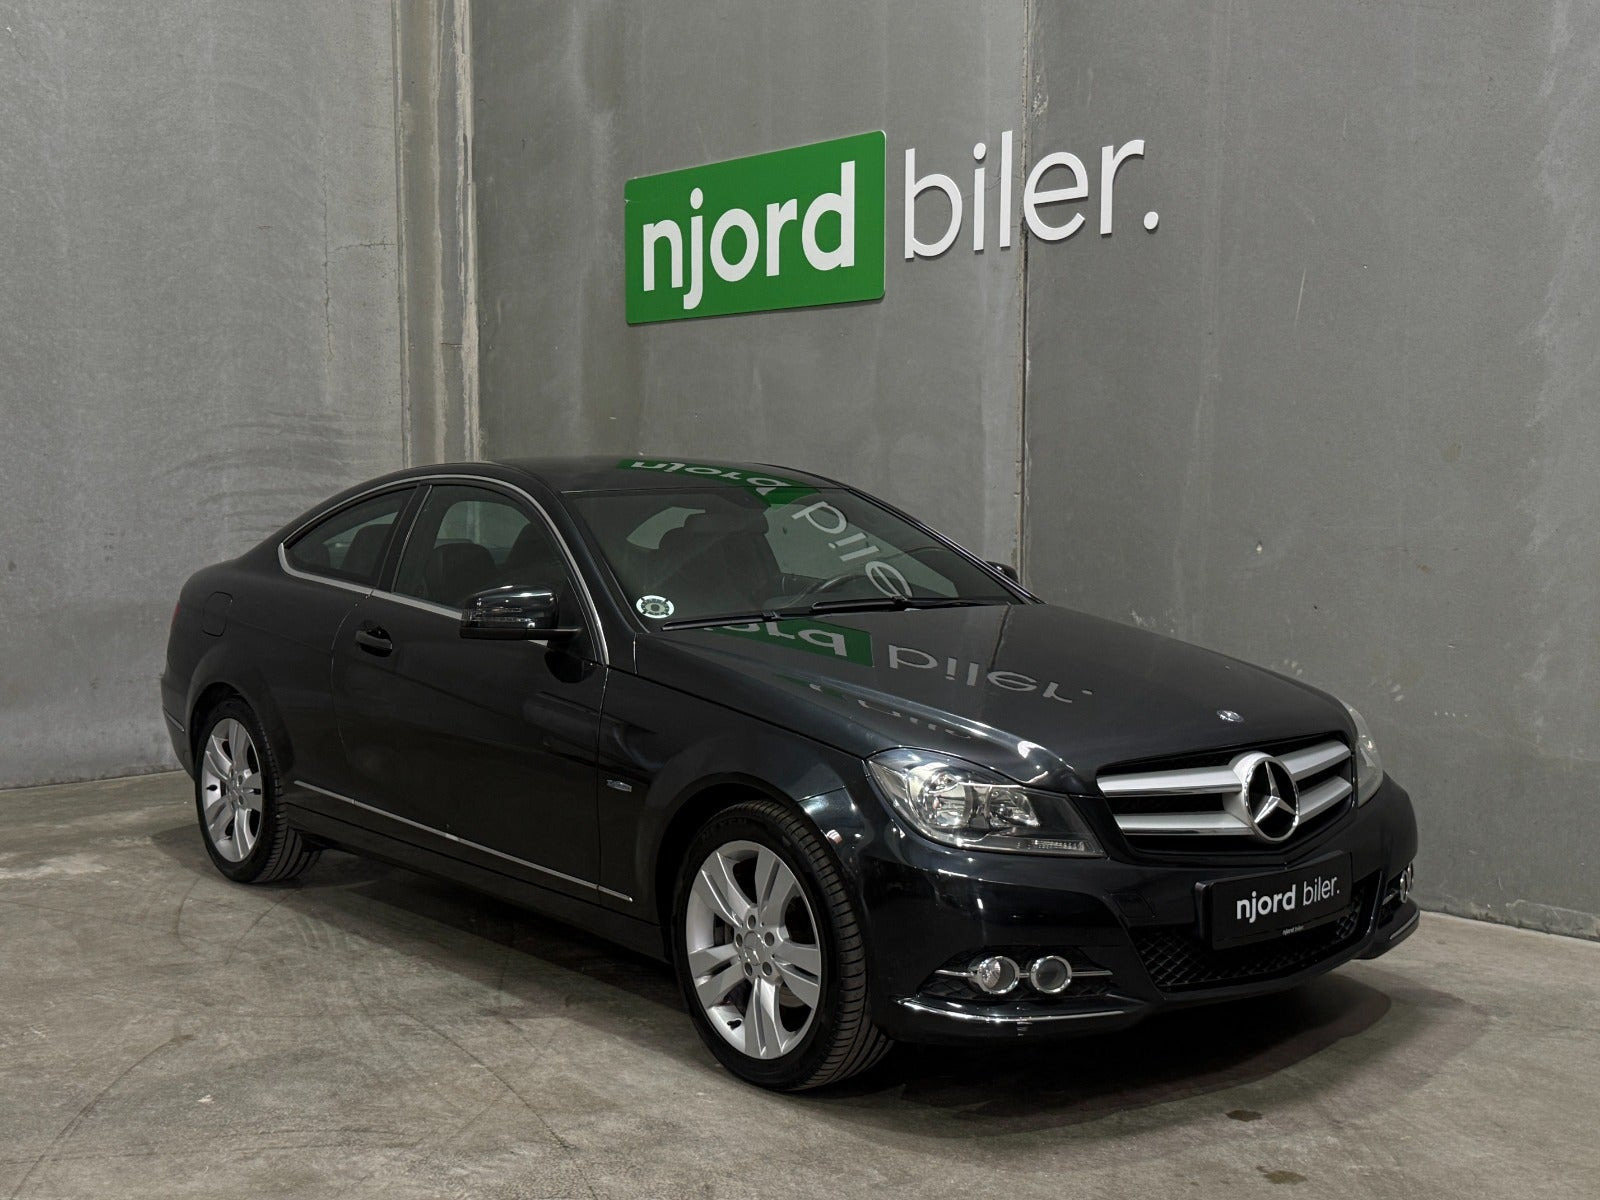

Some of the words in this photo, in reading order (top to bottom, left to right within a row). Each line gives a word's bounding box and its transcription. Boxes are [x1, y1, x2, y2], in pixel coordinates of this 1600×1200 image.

[642, 160, 856, 310] njord
[904, 130, 1160, 260] biler.
[1236, 883, 1297, 924] njord
[1302, 876, 1340, 906] biler.
